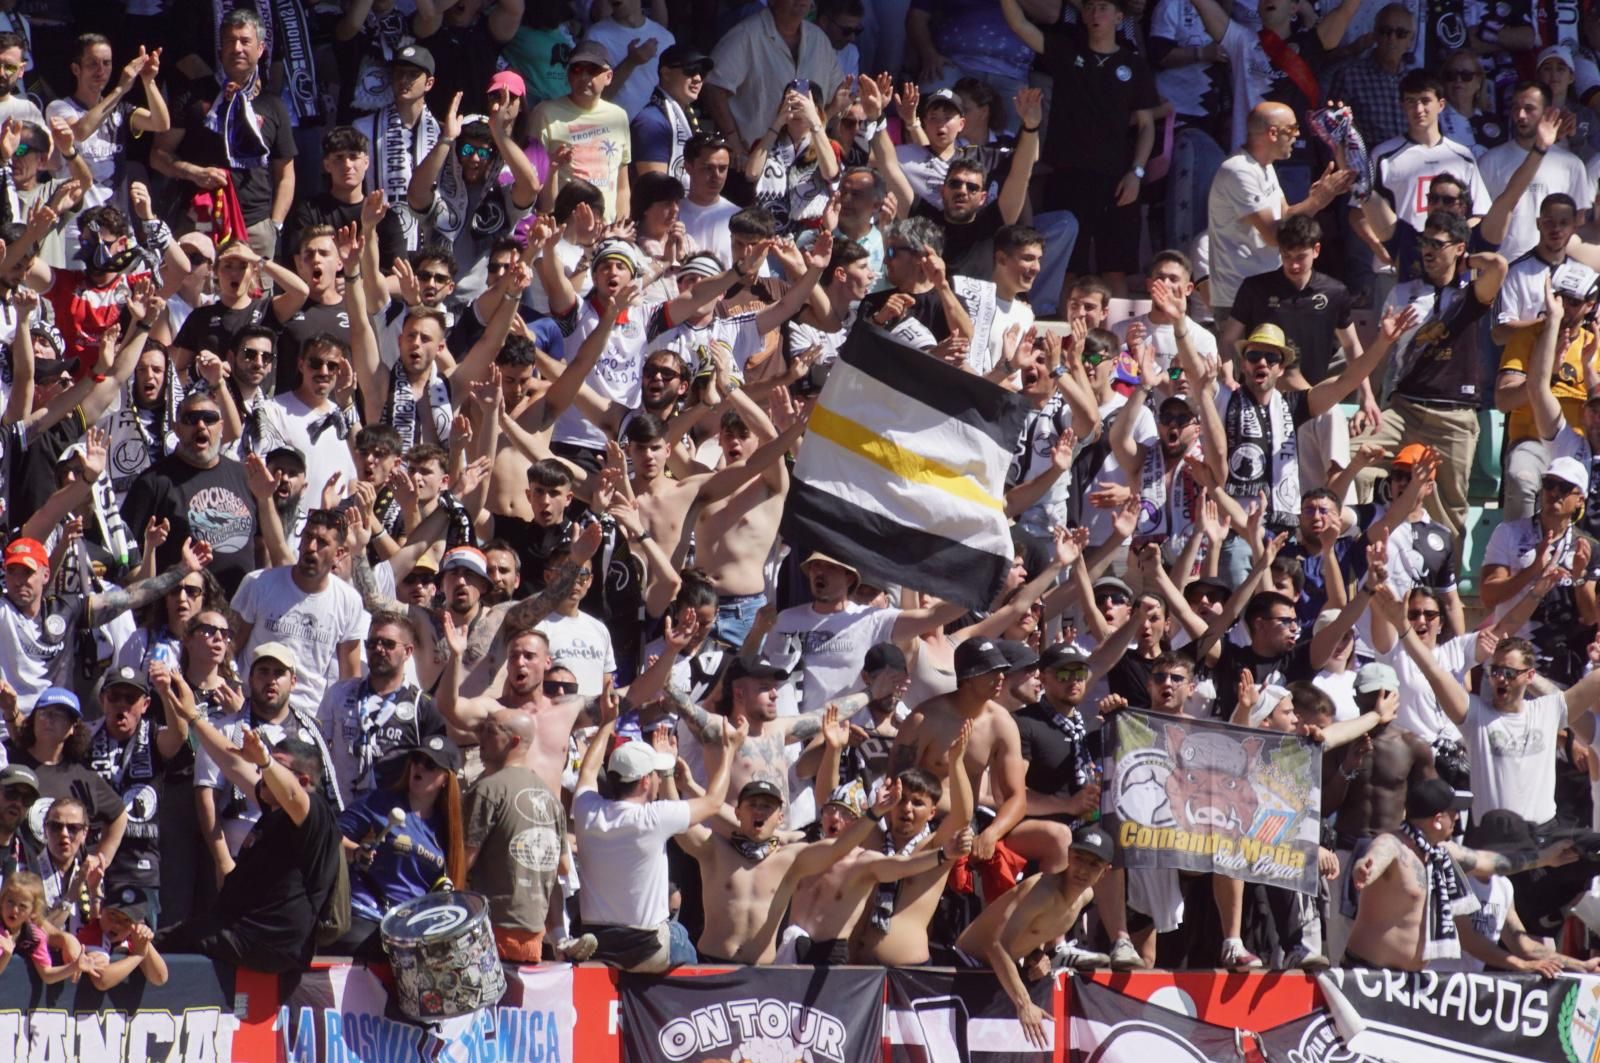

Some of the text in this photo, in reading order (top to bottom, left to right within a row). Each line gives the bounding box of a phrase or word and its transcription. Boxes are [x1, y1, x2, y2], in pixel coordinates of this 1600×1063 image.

[571, 126, 611, 142] TROPICAL
[386, 727, 403, 741] QR
[1119, 820, 1234, 856] Comando
[658, 998, 847, 1063] ON TOUR
